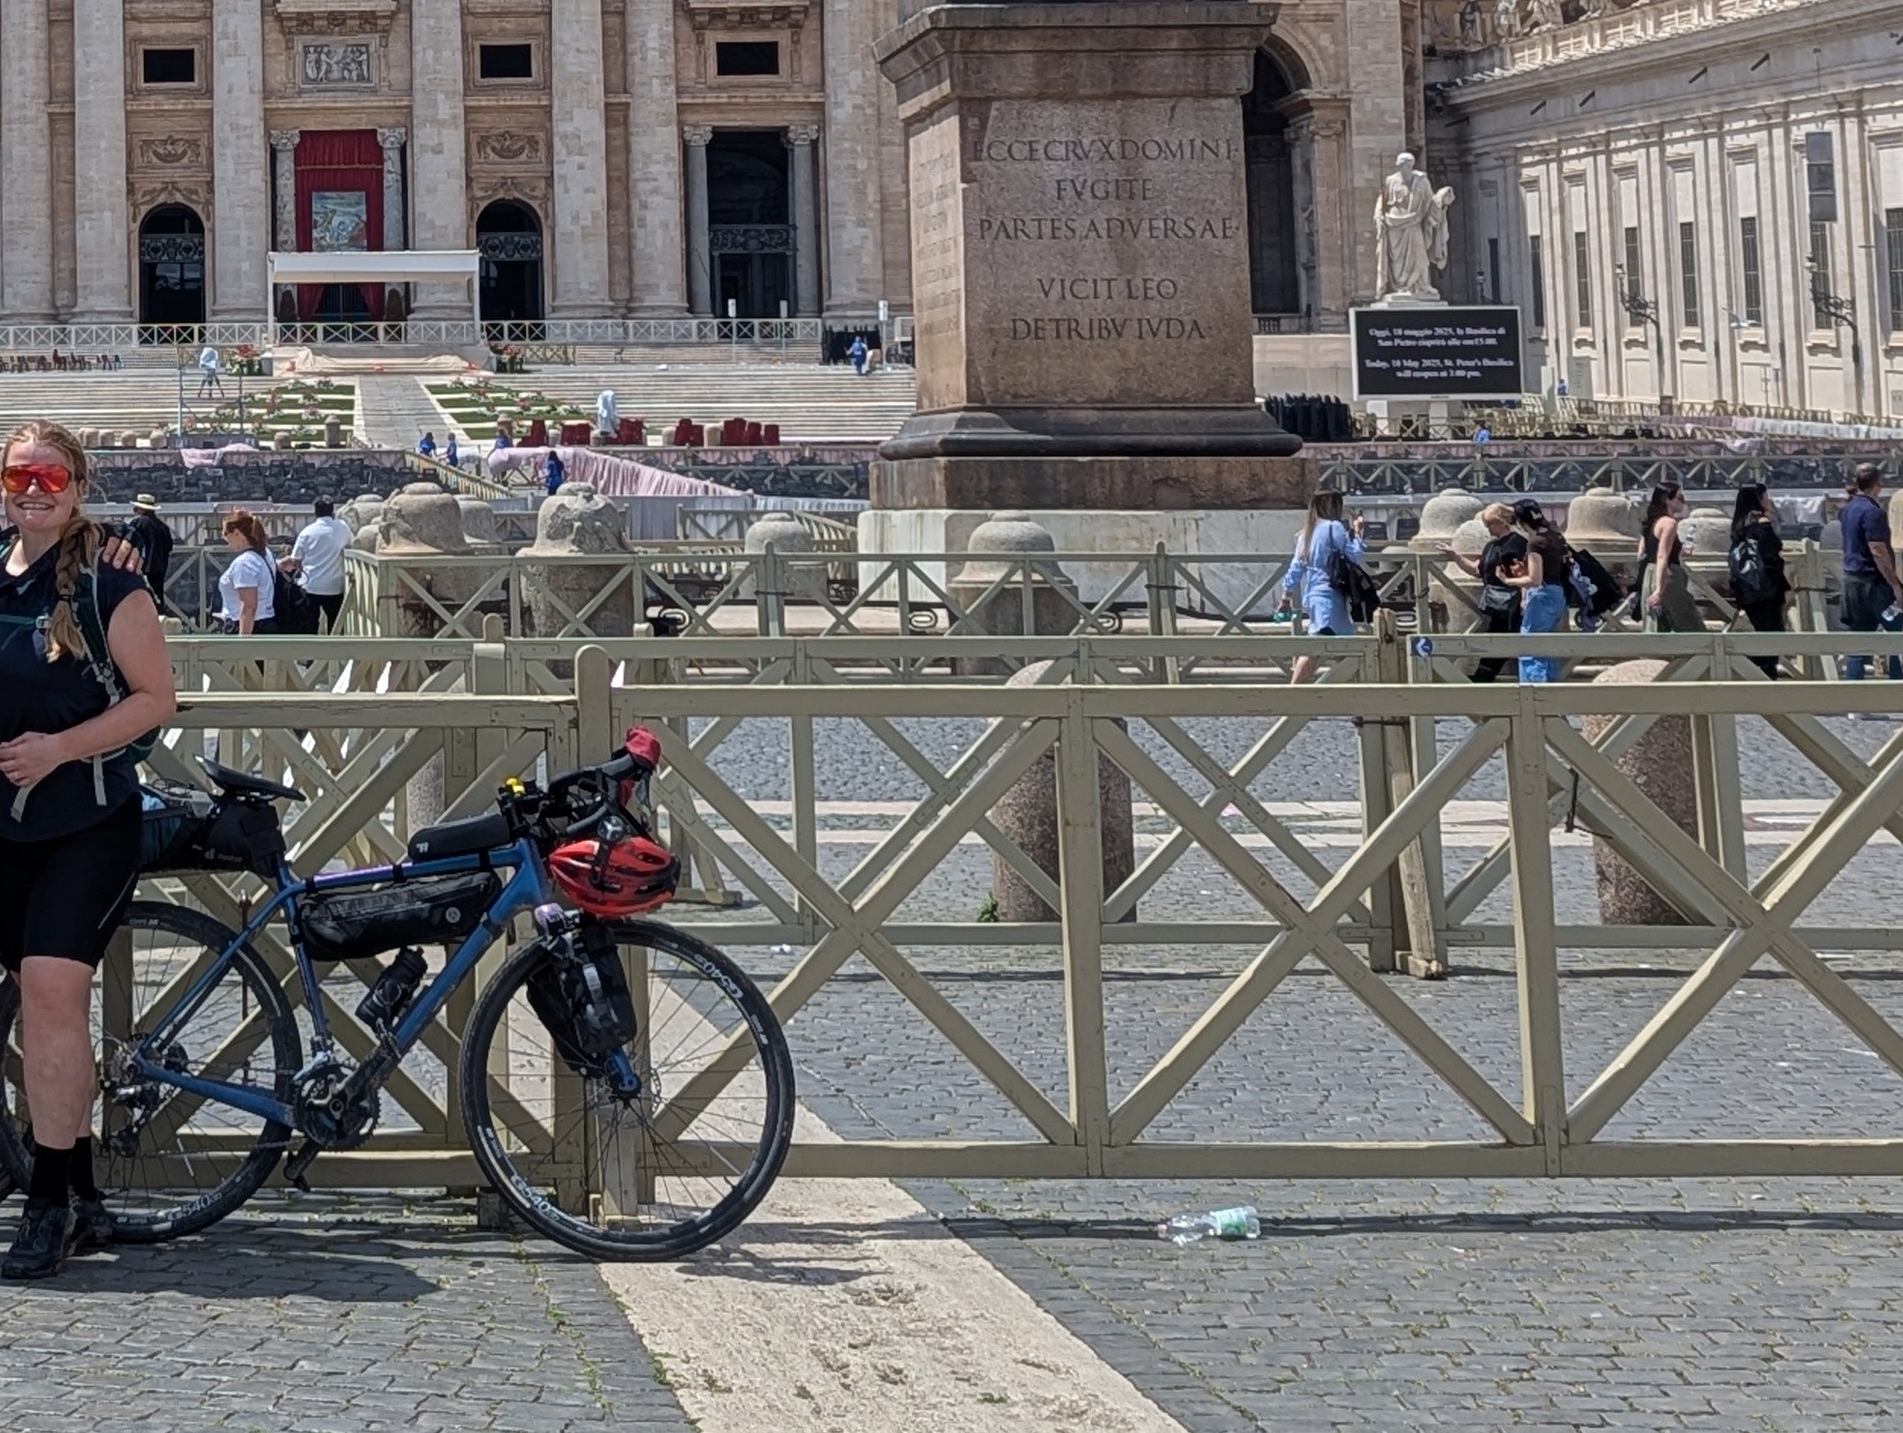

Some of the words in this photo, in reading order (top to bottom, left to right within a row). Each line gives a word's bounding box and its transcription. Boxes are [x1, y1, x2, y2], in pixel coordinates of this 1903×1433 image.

[1055, 177, 1154, 202] FVGITE
[979, 217, 1076, 241] PARTES
[1085, 216, 1235, 241] ADVERSAE
[1036, 276, 1119, 301] VICIT
[1127, 276, 1179, 301] LEO
[1137, 317, 1207, 341] IVDA
